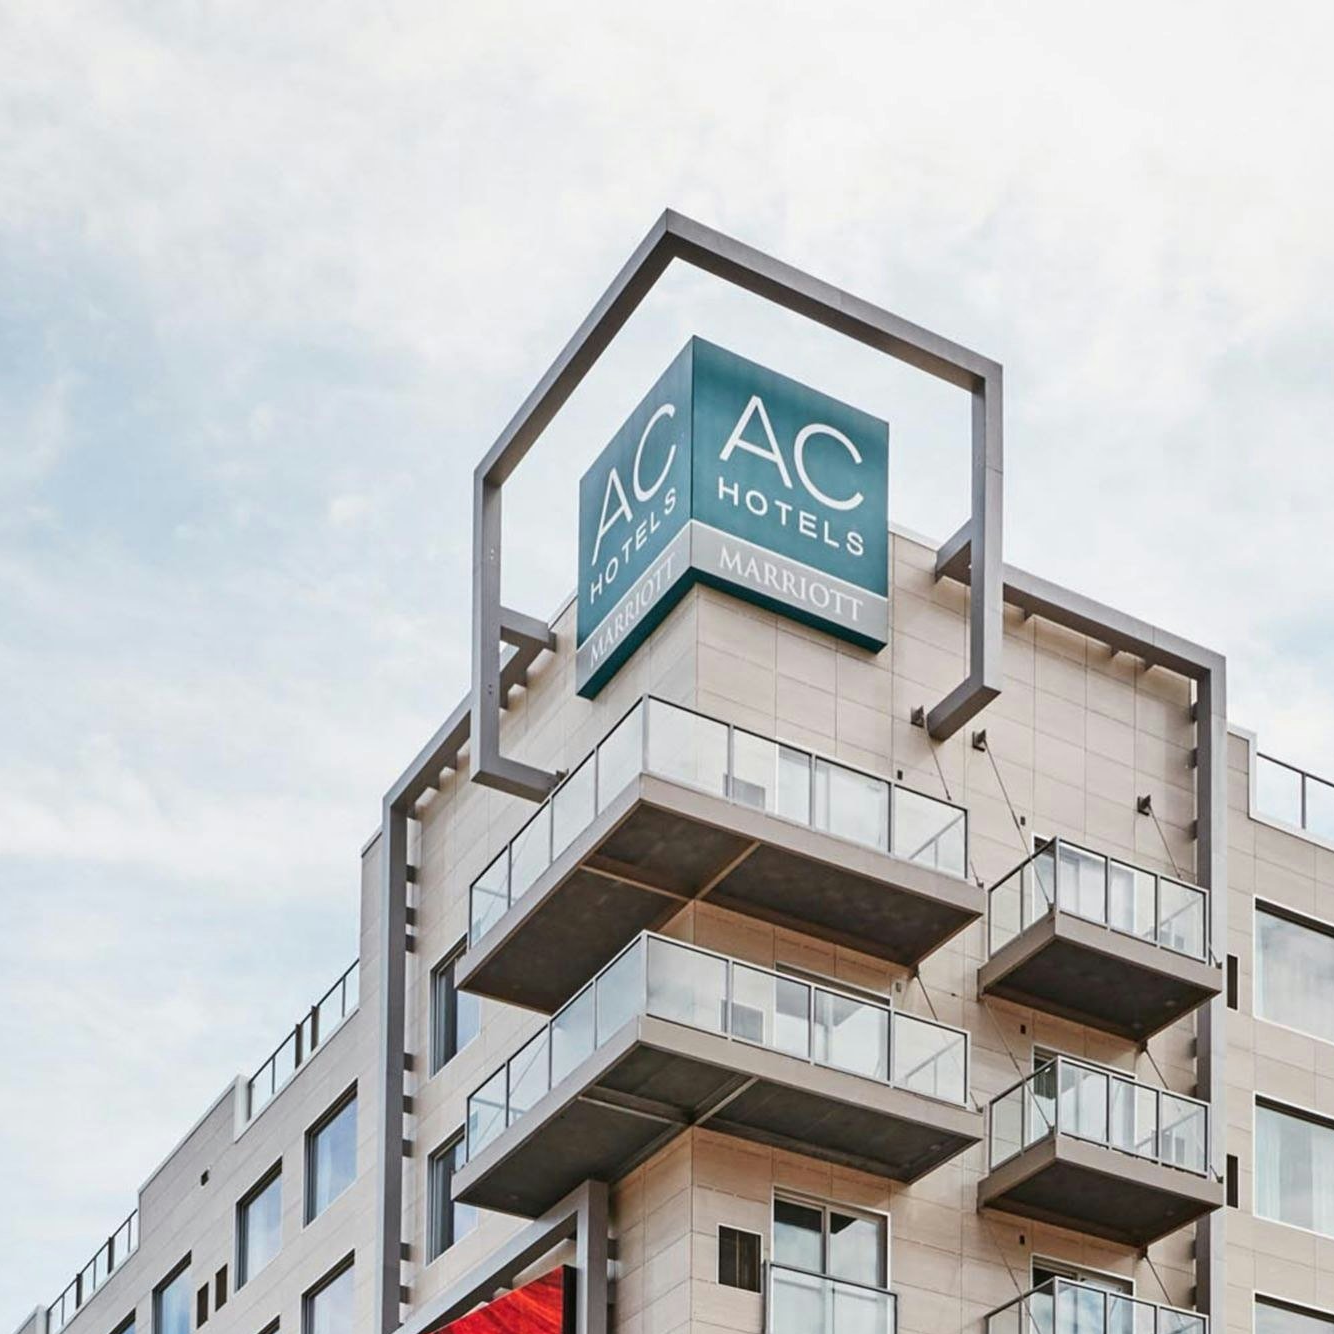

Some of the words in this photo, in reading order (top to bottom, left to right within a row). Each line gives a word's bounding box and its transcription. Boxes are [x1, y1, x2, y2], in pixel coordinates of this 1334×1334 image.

[592, 403, 677, 566] AC
[718, 395, 865, 511] AC
[589, 487, 677, 605] HOTELS
[717, 476, 865, 557] HOTELS
[588, 549, 679, 670] MARRIOTT
[719, 546, 864, 623] MARRIOTT
